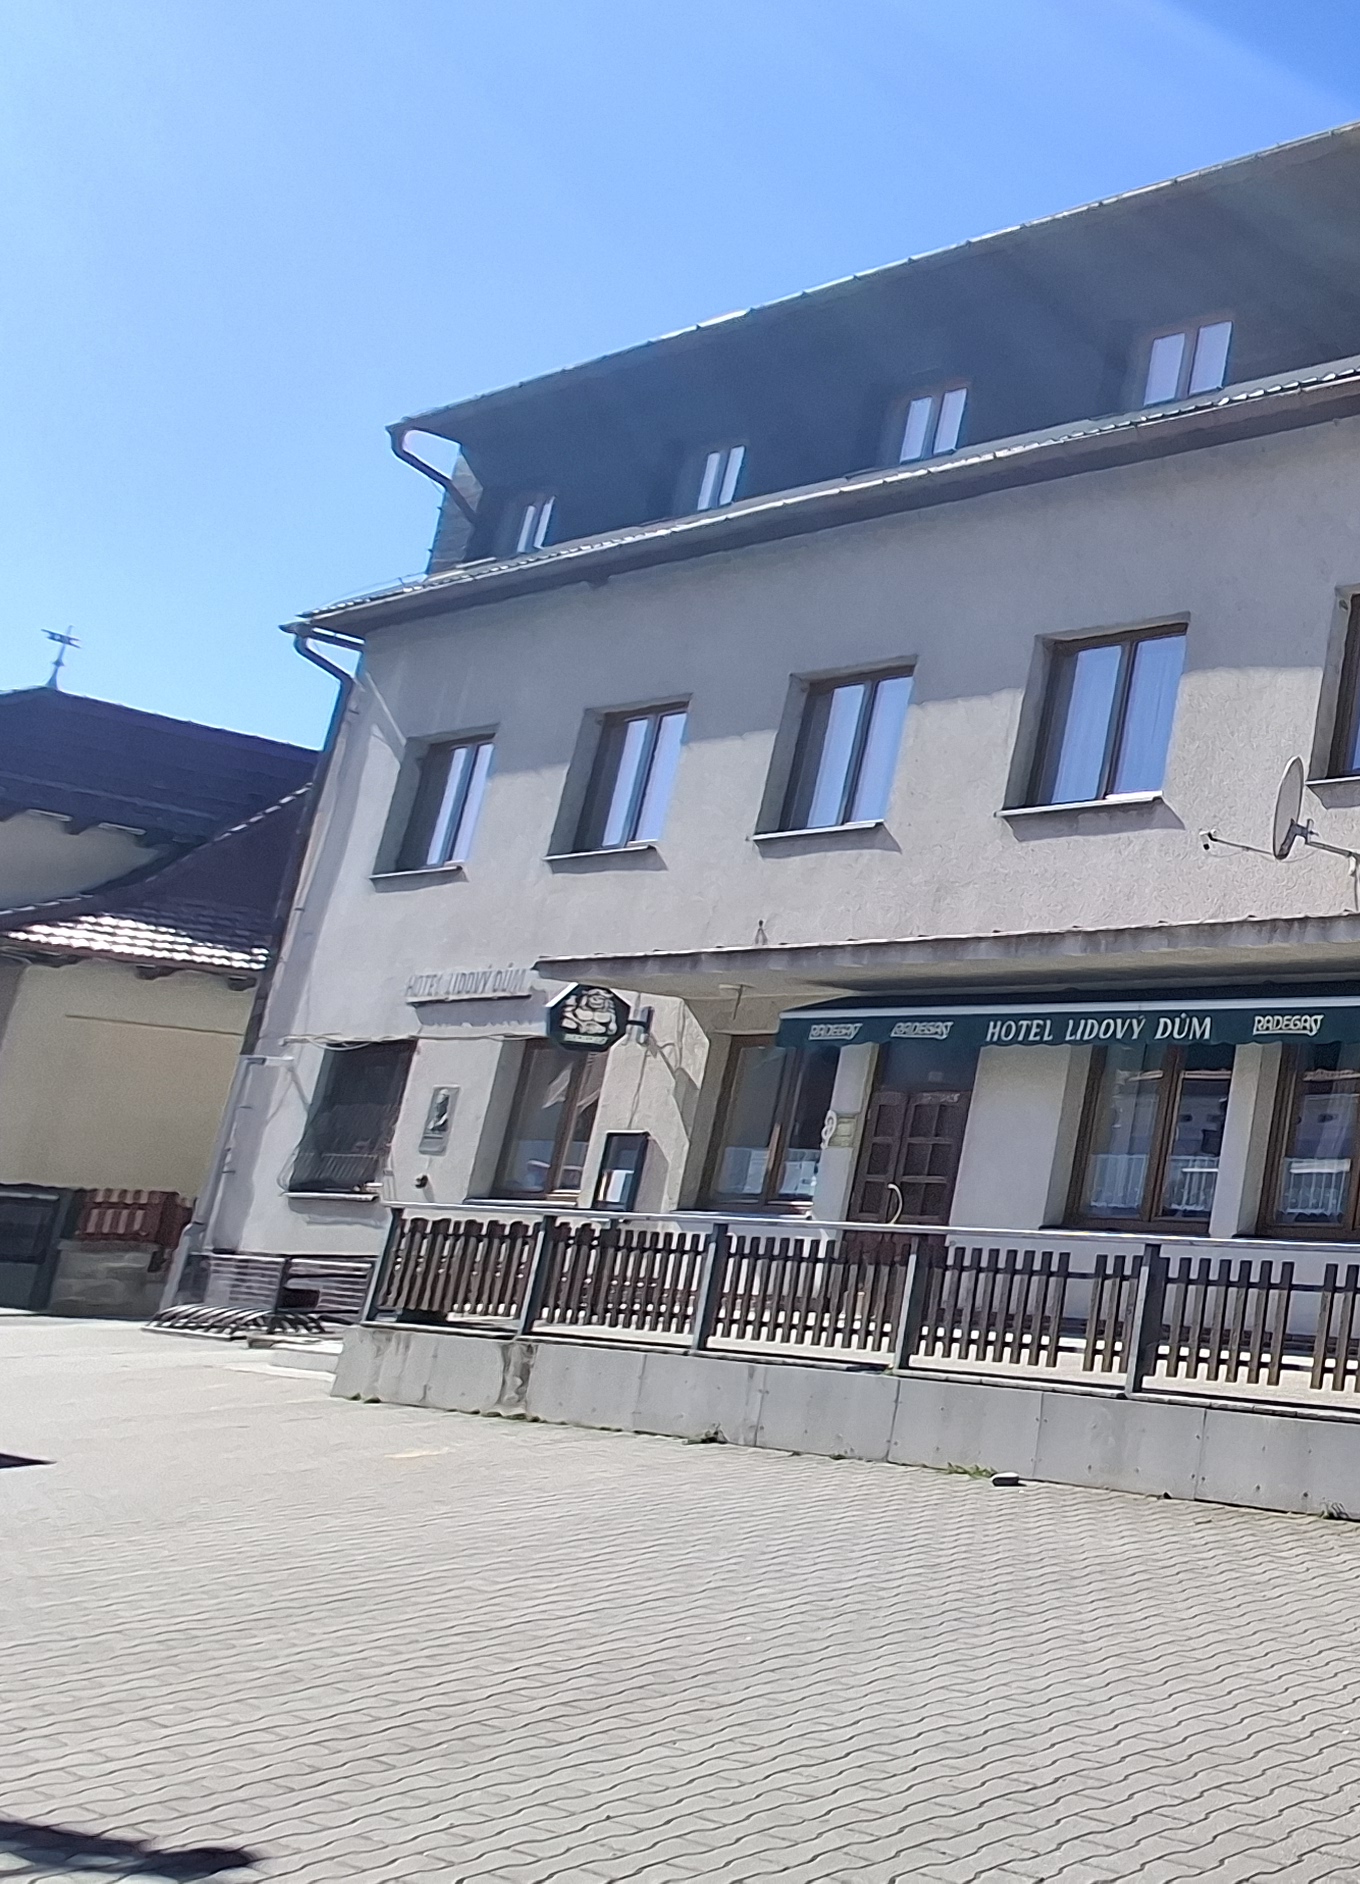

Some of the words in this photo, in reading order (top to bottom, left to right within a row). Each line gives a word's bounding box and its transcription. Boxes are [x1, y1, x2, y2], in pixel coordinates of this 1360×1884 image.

[986, 1020, 1053, 1041] HOTEL
[1065, 1015, 1145, 1041] LIDOVÝ
[1153, 1012, 1212, 1040] DŮM
[1253, 1014, 1324, 1036] RADEGAST
